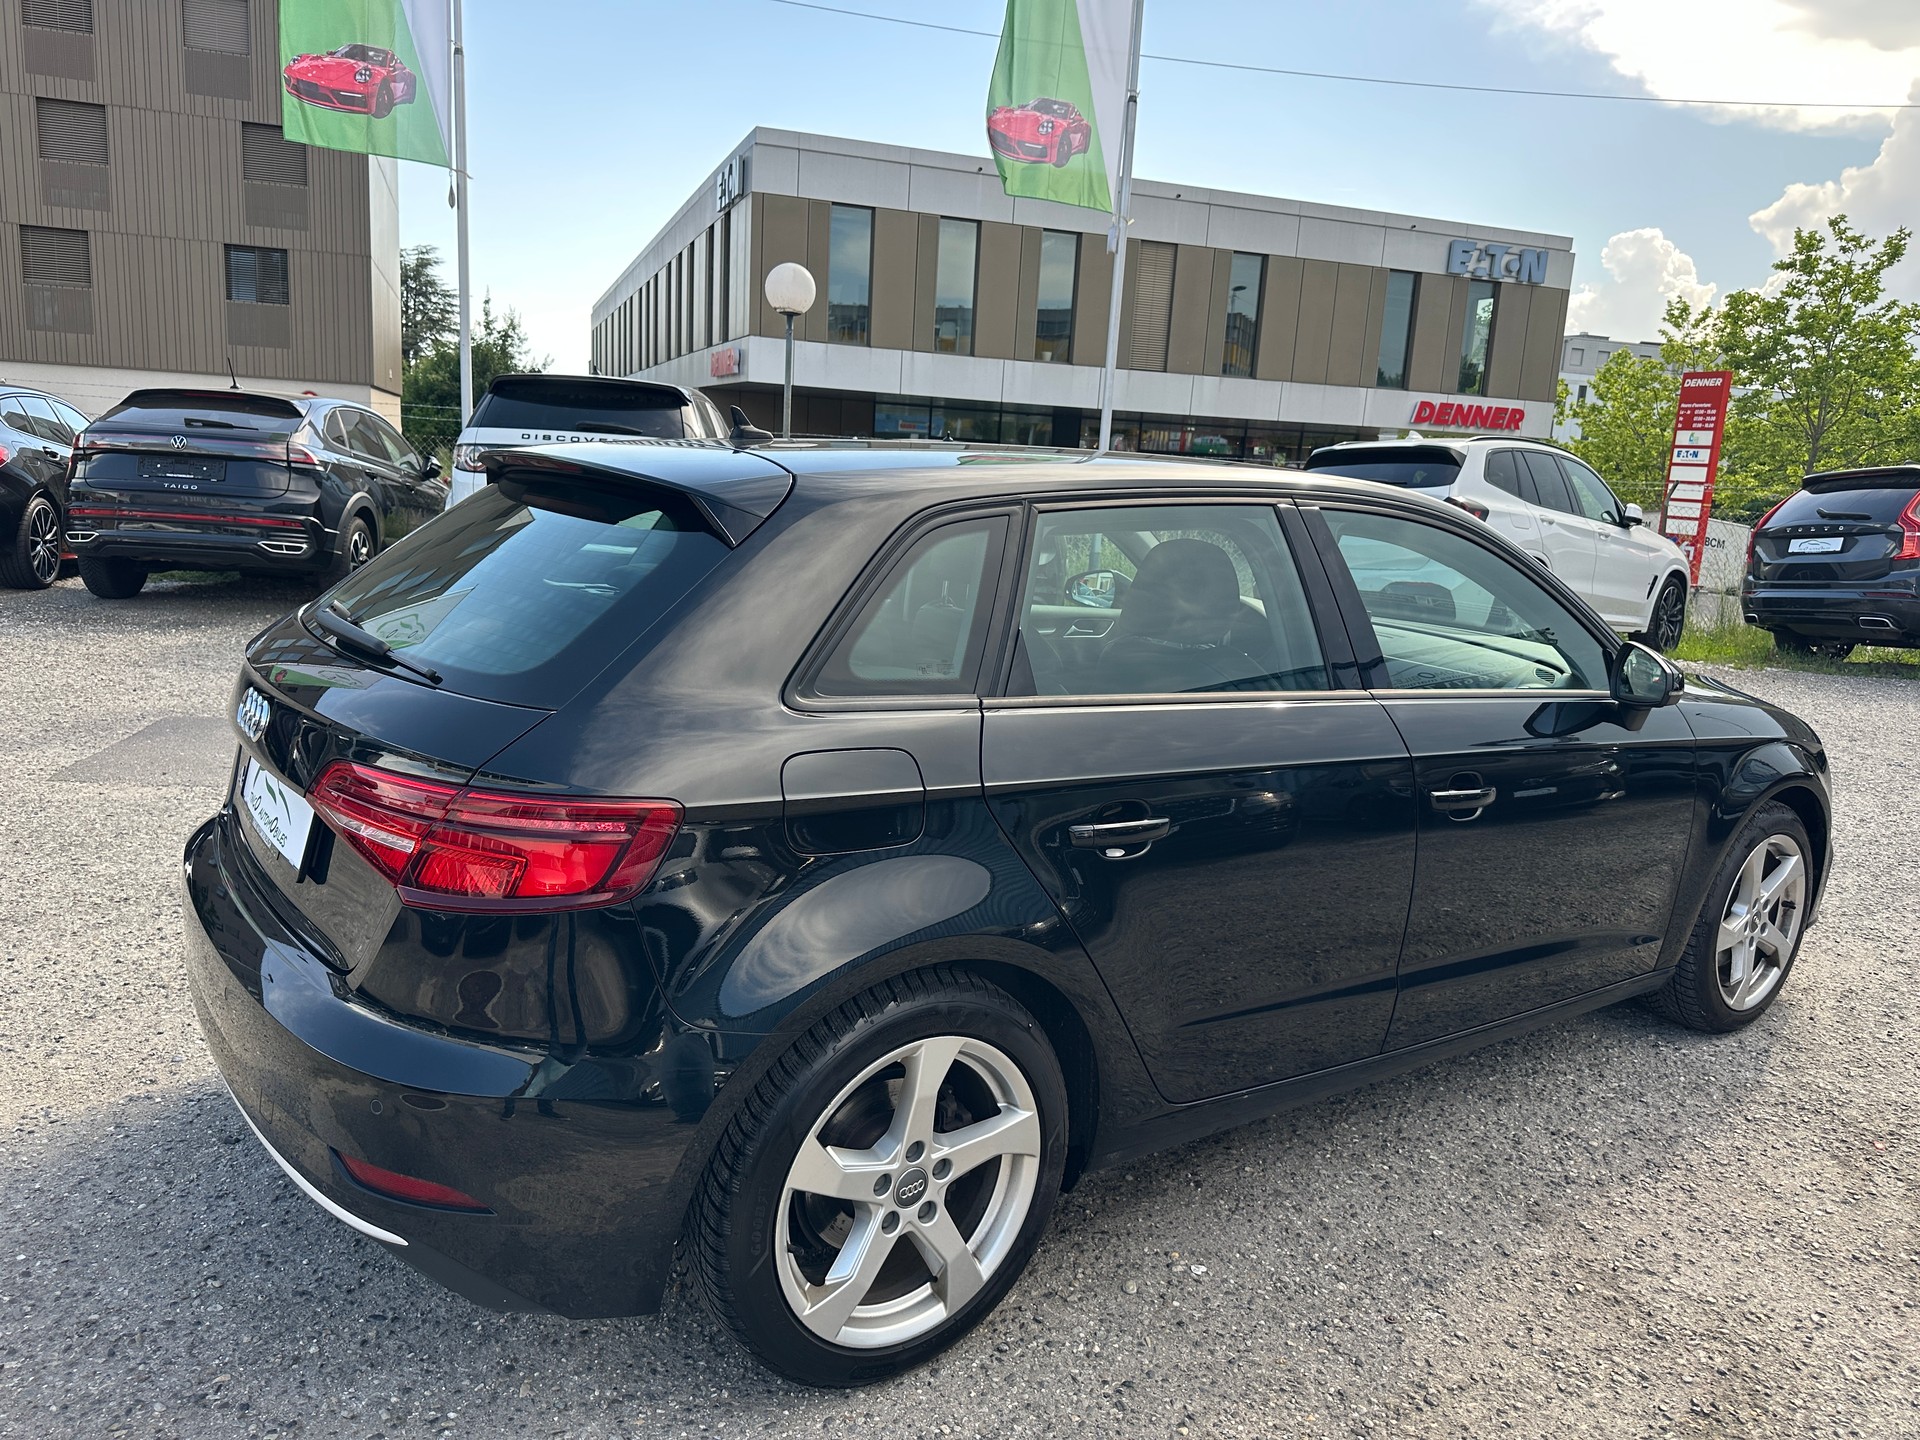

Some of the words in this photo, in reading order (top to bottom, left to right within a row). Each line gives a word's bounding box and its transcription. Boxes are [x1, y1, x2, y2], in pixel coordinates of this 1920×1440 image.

[1447, 239, 1549, 284] EATON
[1684, 378, 1723, 387] DENNER
[1411, 400, 1525, 430] DENNER
[521, 433, 617, 443] DISCOVE
[1676, 450, 1699, 458] EATON
[163, 482, 198, 490] TAIGO
[1705, 536, 1726, 549] BCM
